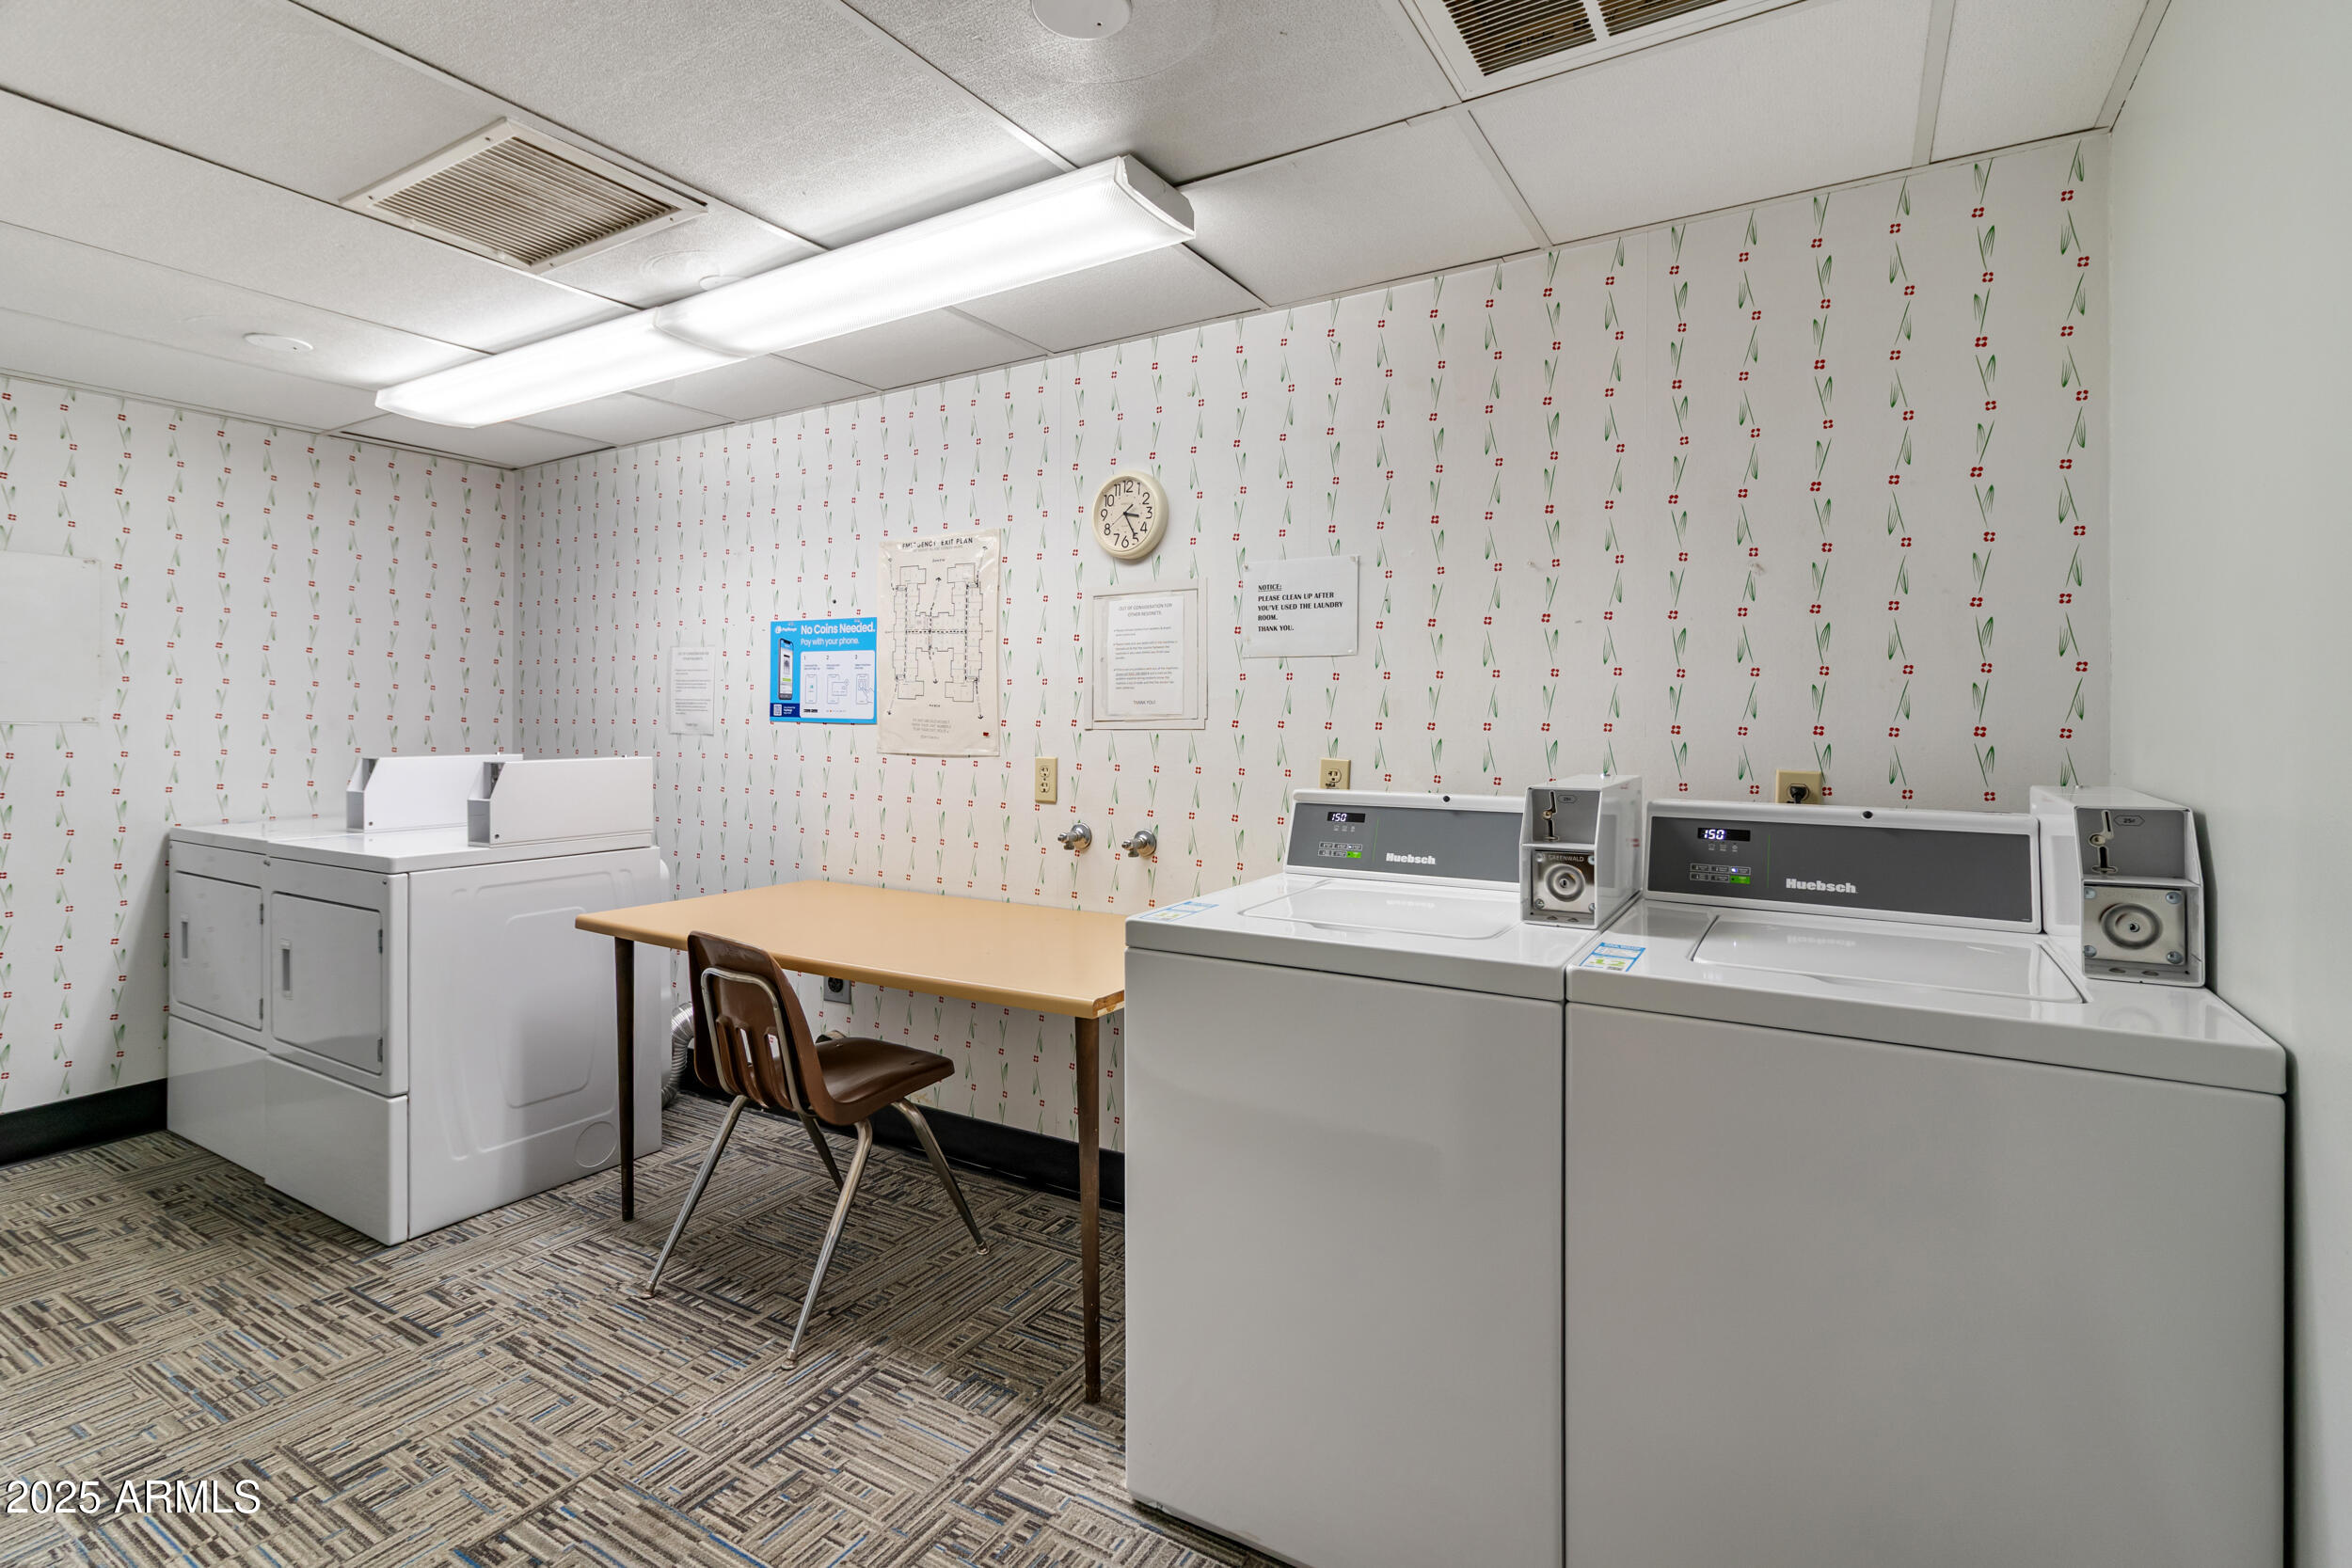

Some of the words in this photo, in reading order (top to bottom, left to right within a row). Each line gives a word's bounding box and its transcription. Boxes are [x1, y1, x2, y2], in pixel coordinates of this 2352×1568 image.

[1114, 483, 1121, 497] 11
[1122, 481, 1133, 493] 12
[1137, 483, 1140, 495] 1
[1104, 494, 1115, 507] 10
[1142, 492, 1150, 505] 2
[1101, 509, 1107, 521] 9
[1146, 506, 1152, 519] 3
[1104, 523, 1111, 535] 8
[1140, 521, 1148, 533] 4
[1113, 533, 1120, 546] 7
[1121, 535, 1129, 548] 6
[1132, 532, 1138, 546] 5
[1258, 584, 1282, 593] NOTICE:
[801, 625, 812, 635] No
[814, 624, 838, 634] Coins
[839, 622, 875, 633] Needed.
[801, 639, 810, 647] Pay
[825, 639, 838, 647] your
[839, 638, 860, 646] phone.
[1331, 813, 1347, 822] 150
[1704, 829, 1725, 840] 150
[1386, 852, 1436, 865] Huebsch
[1786, 878, 1857, 894] Huebsch
